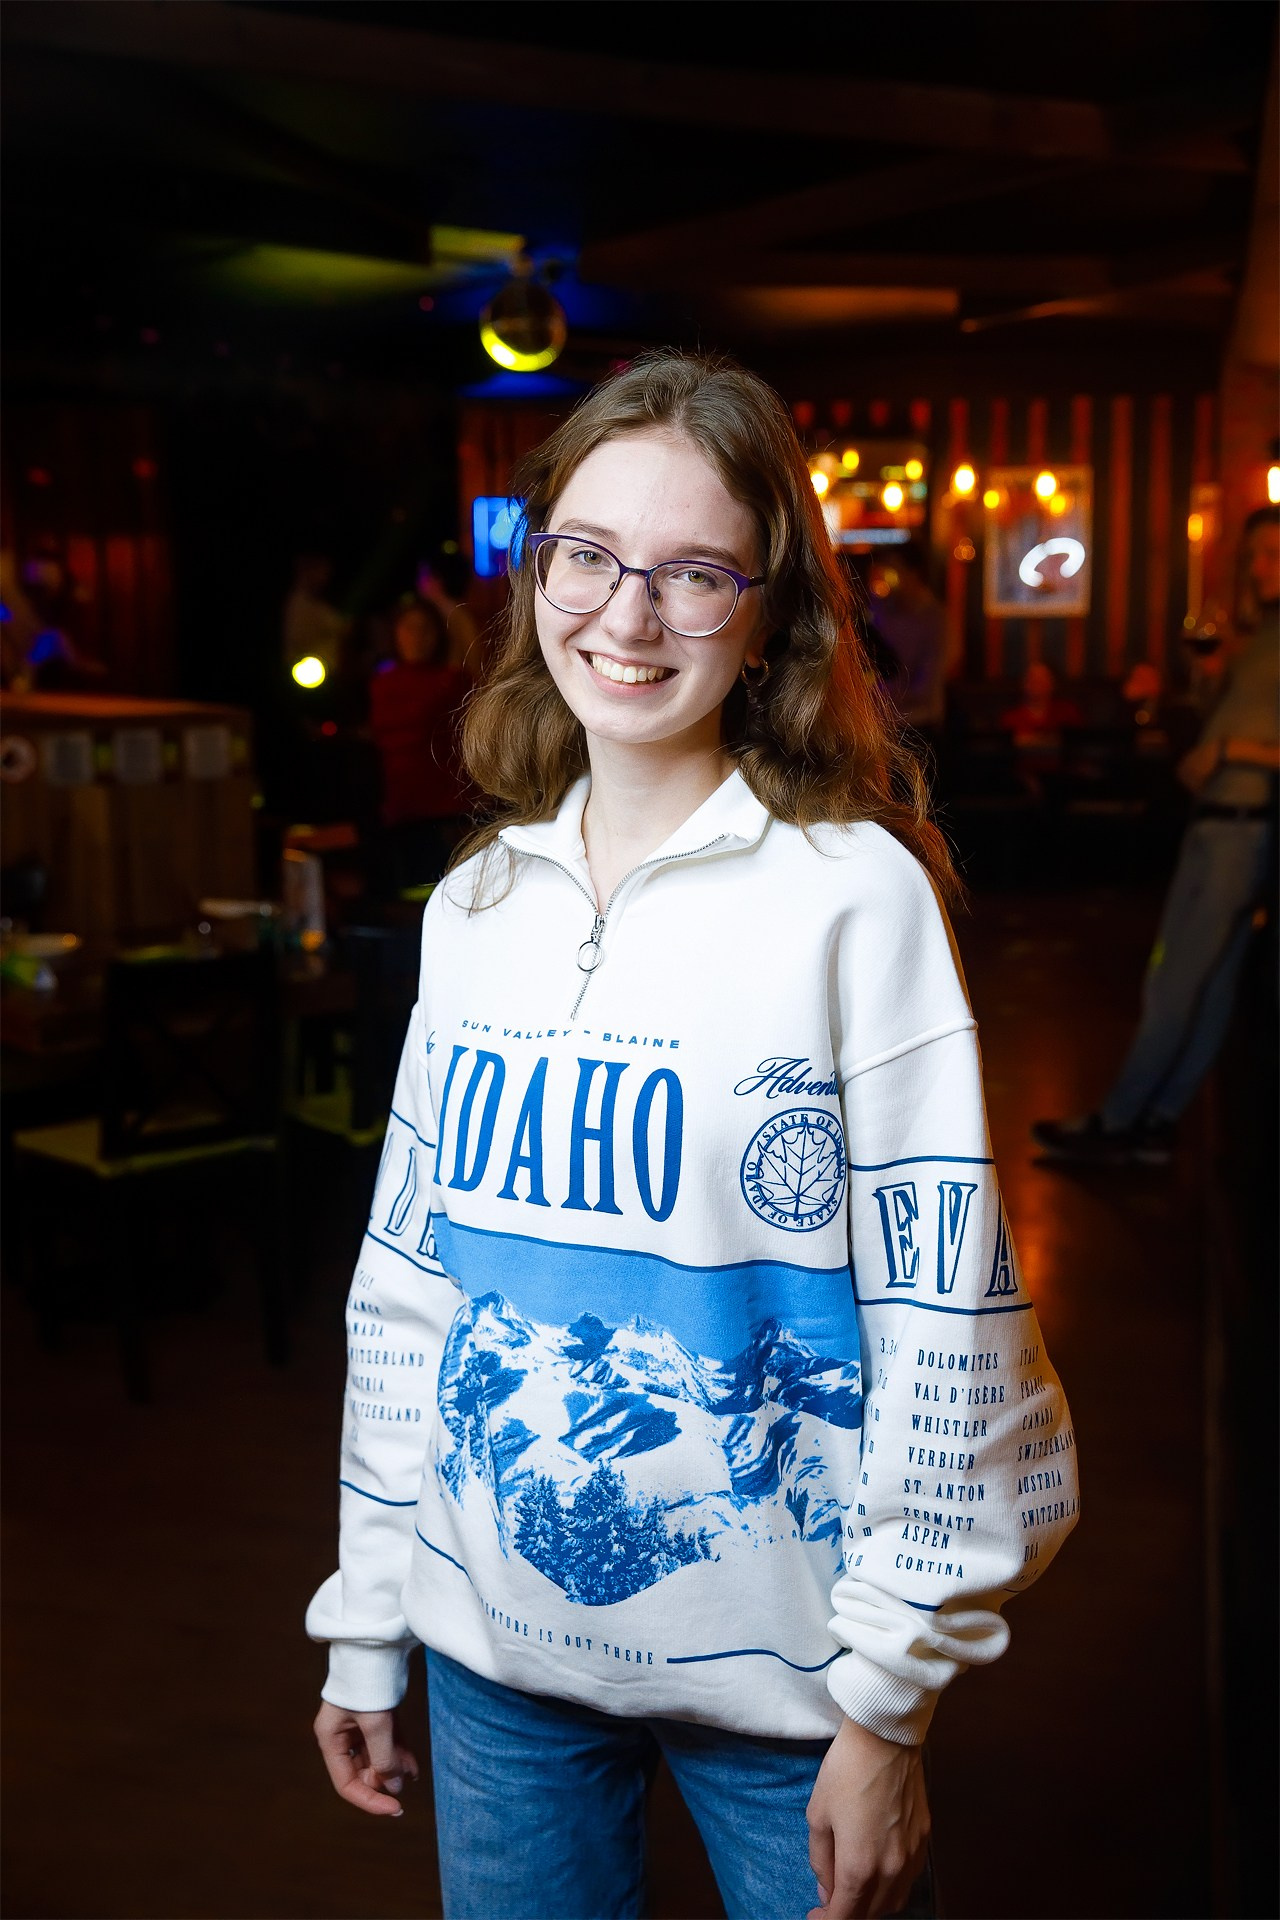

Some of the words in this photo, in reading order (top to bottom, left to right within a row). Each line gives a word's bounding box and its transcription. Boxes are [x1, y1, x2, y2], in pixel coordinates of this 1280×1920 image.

[461, 1020, 491, 1033] SUN
[503, 1028, 572, 1040] VALLEY
[603, 1032, 680, 1049] BLAINE
[432, 1044, 685, 1222] IDAHO
[762, 1113, 810, 1142] STATE
[816, 1115, 833, 1131] OF
[348, 1322, 384, 1337] NADA
[917, 1348, 999, 1373] DOLOMITES
[914, 1382, 940, 1402] VAL
[911, 1414, 988, 1438] WHISTLER
[1022, 1407, 1054, 1431] CANADA
[908, 1446, 975, 1471] VERBIER
[1018, 1429, 1076, 1462] SWITZERLAN
[904, 1478, 927, 1496] ST.
[936, 1482, 985, 1502] ANTON
[1017, 1469, 1062, 1495] AUSTRIA
[903, 1507, 975, 1532] ZERMATT
[1022, 1496, 1080, 1529] SWITZERLA
[902, 1523, 950, 1550] ASPEN
[896, 1553, 964, 1579] CORTINA
[539, 1628, 553, 1643] IS
[564, 1634, 592, 1651] OUT
[604, 1643, 653, 1665] THERE
